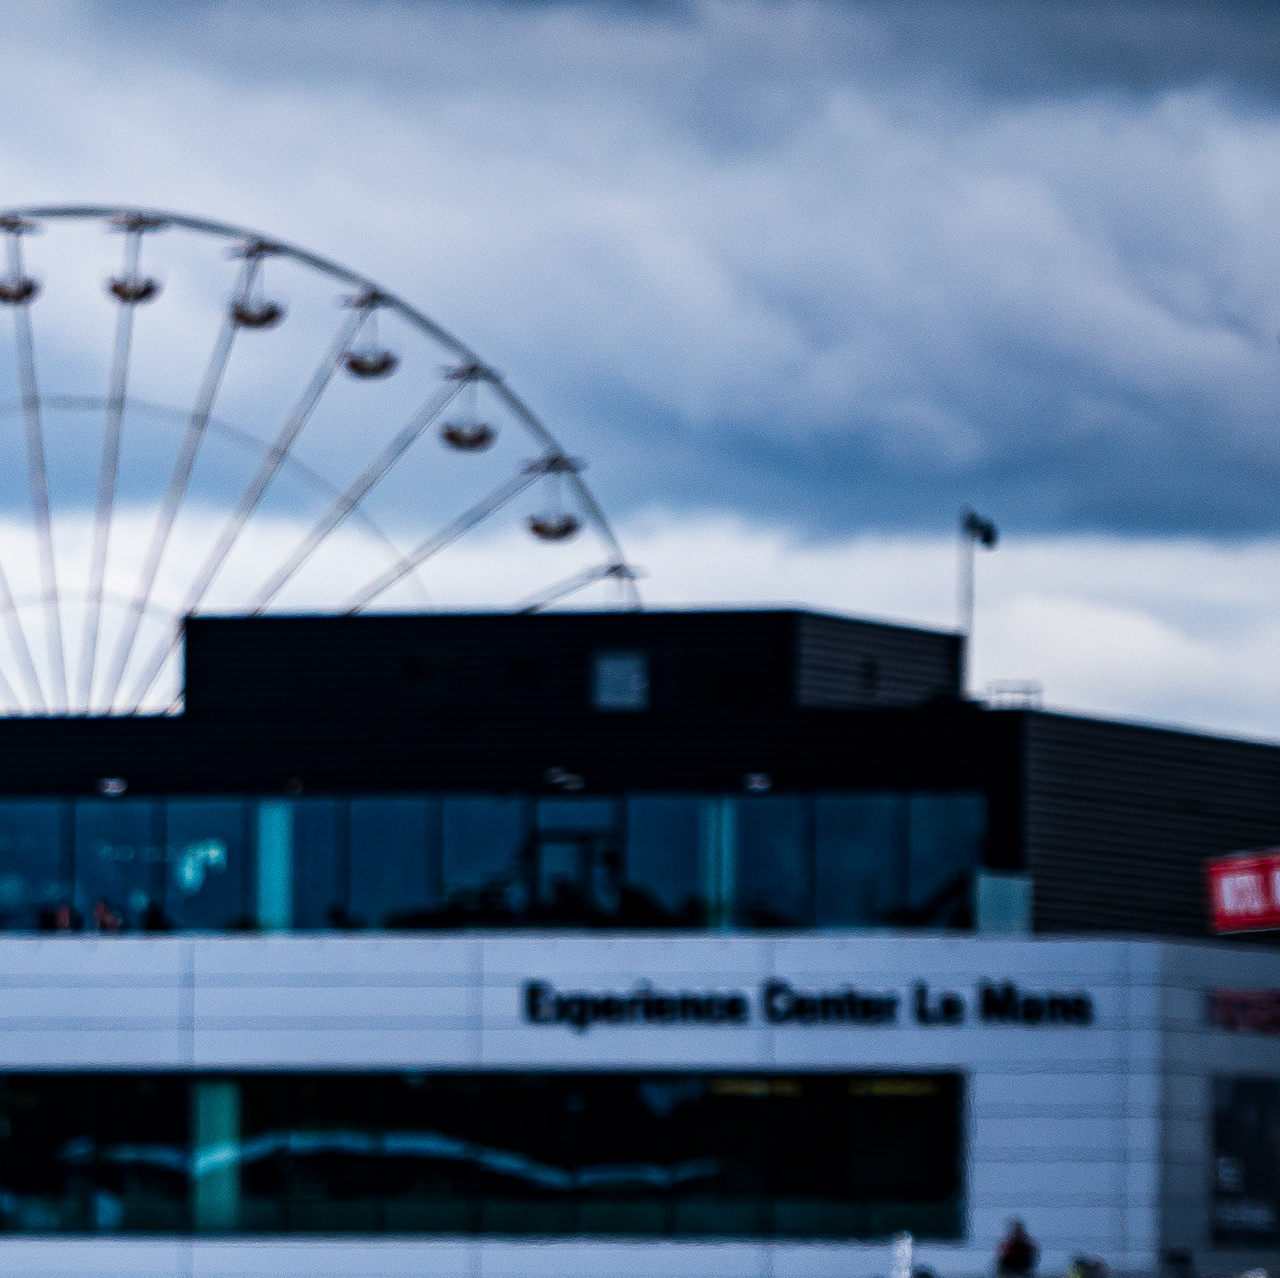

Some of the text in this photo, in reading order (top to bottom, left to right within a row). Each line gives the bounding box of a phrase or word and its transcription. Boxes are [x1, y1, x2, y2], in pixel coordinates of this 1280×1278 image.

[524, 977, 1093, 1034] Experience Center Le Mans
